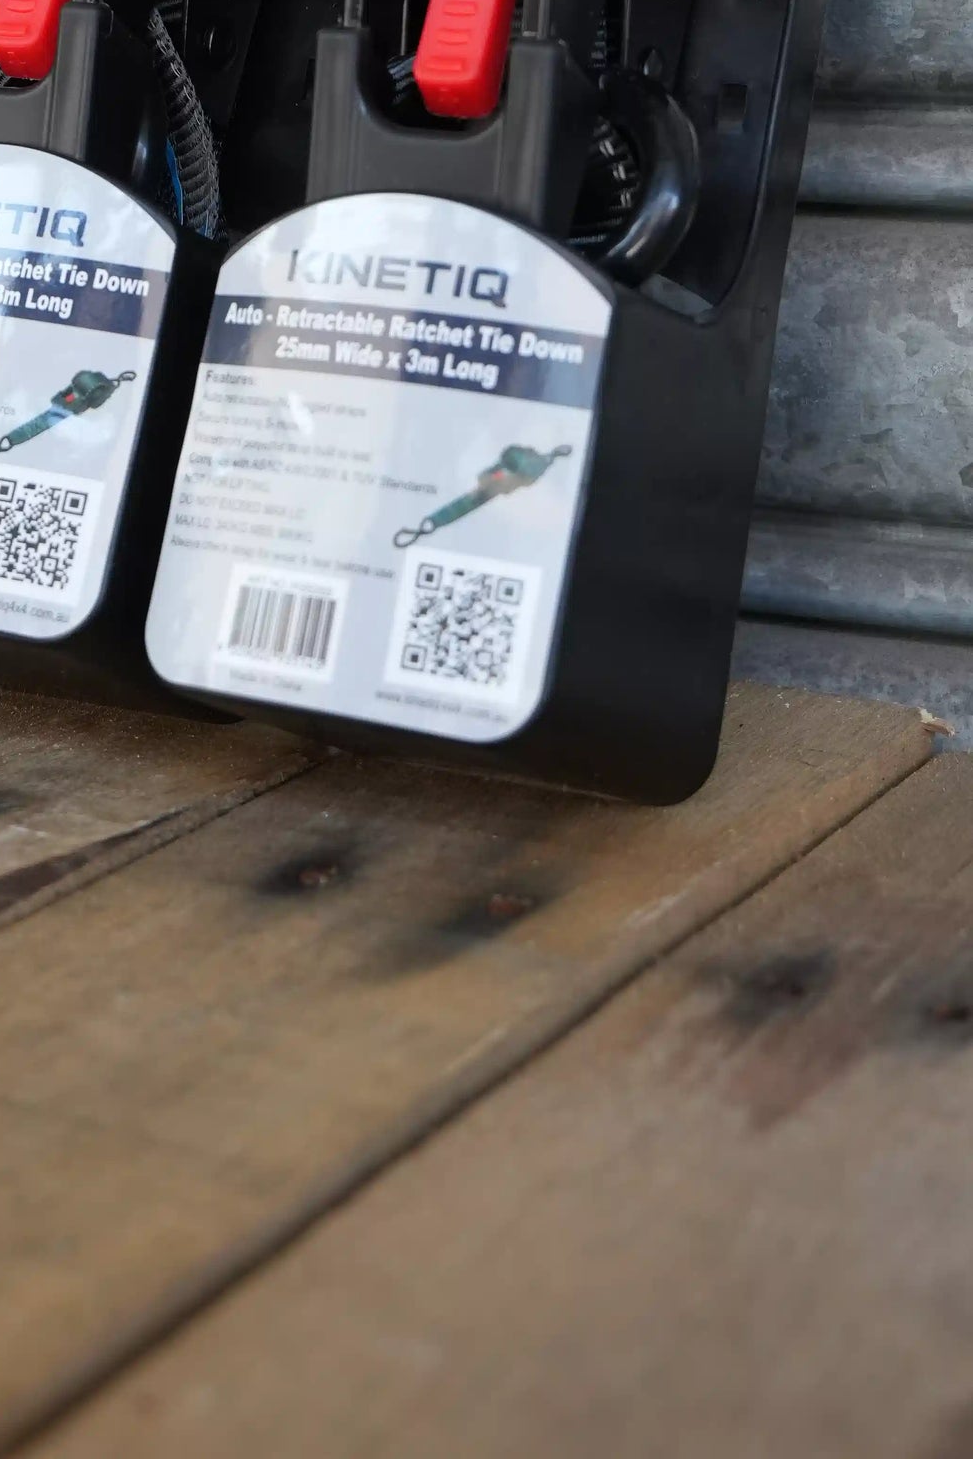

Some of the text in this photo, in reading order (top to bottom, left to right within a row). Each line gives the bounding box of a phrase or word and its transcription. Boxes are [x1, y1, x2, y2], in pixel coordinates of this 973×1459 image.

[23, 288, 75, 319] Long
[56, 262, 91, 287] Tie
[92, 266, 152, 297] Down
[284, 248, 512, 309] KINETIQ
[223, 302, 264, 325] Auto
[274, 305, 387, 336] Retractable
[390, 316, 474, 348] Ratchet
[478, 326, 515, 354] Tie
[518, 331, 585, 365] Down
[273, 336, 499, 390] 25mm Wide x 3m Long
